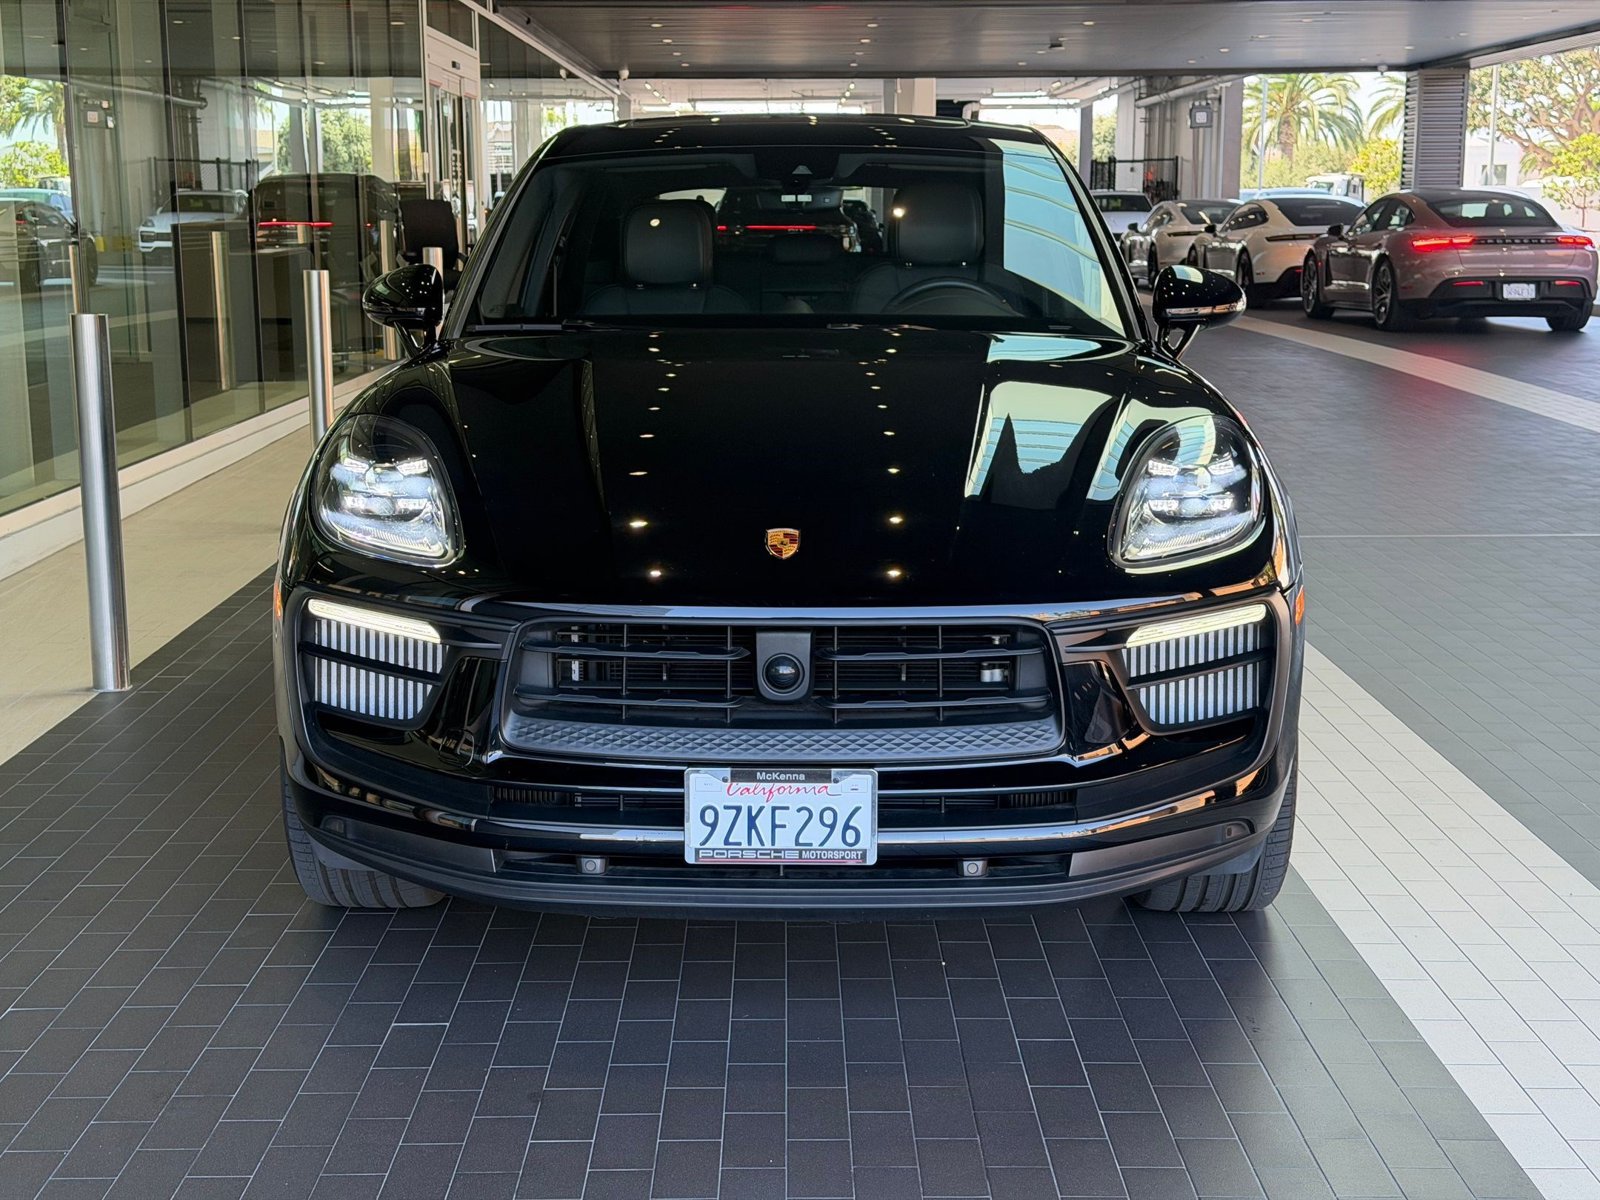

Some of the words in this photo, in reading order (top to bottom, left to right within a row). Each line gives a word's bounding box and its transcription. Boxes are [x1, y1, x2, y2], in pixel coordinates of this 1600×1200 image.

[756, 772, 806, 781] McKenna
[726, 783, 842, 803] California
[699, 804, 862, 847] 9ZKF296
[699, 850, 799, 859] PORSCHE
[801, 851, 863, 859] MOTORSPORT
